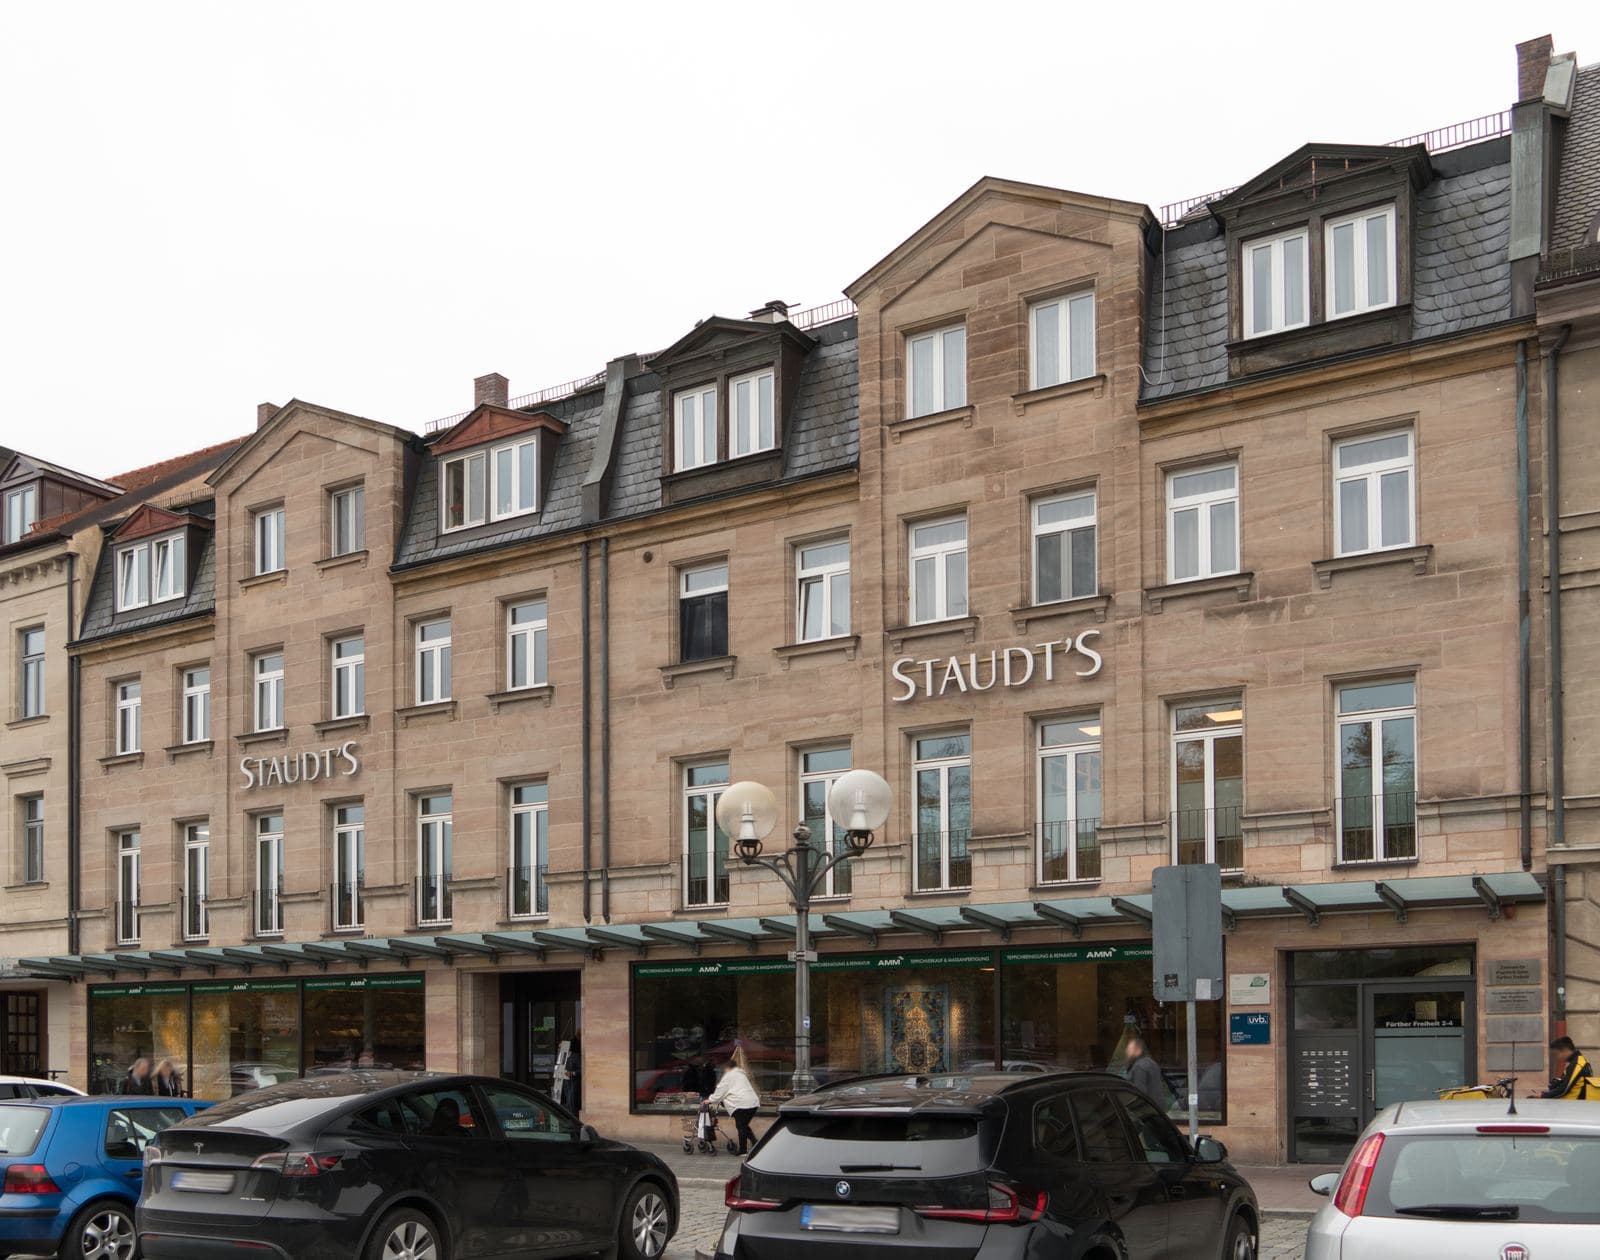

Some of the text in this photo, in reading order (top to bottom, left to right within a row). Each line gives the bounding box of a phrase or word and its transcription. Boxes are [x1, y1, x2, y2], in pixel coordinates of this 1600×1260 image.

[891, 629, 1102, 701] STAUDT'S
[239, 740, 358, 789] STAUDT'S
[1086, 950, 1114, 959] AMM
[878, 958, 902, 966] AMM
[698, 965, 720, 974] AMM
